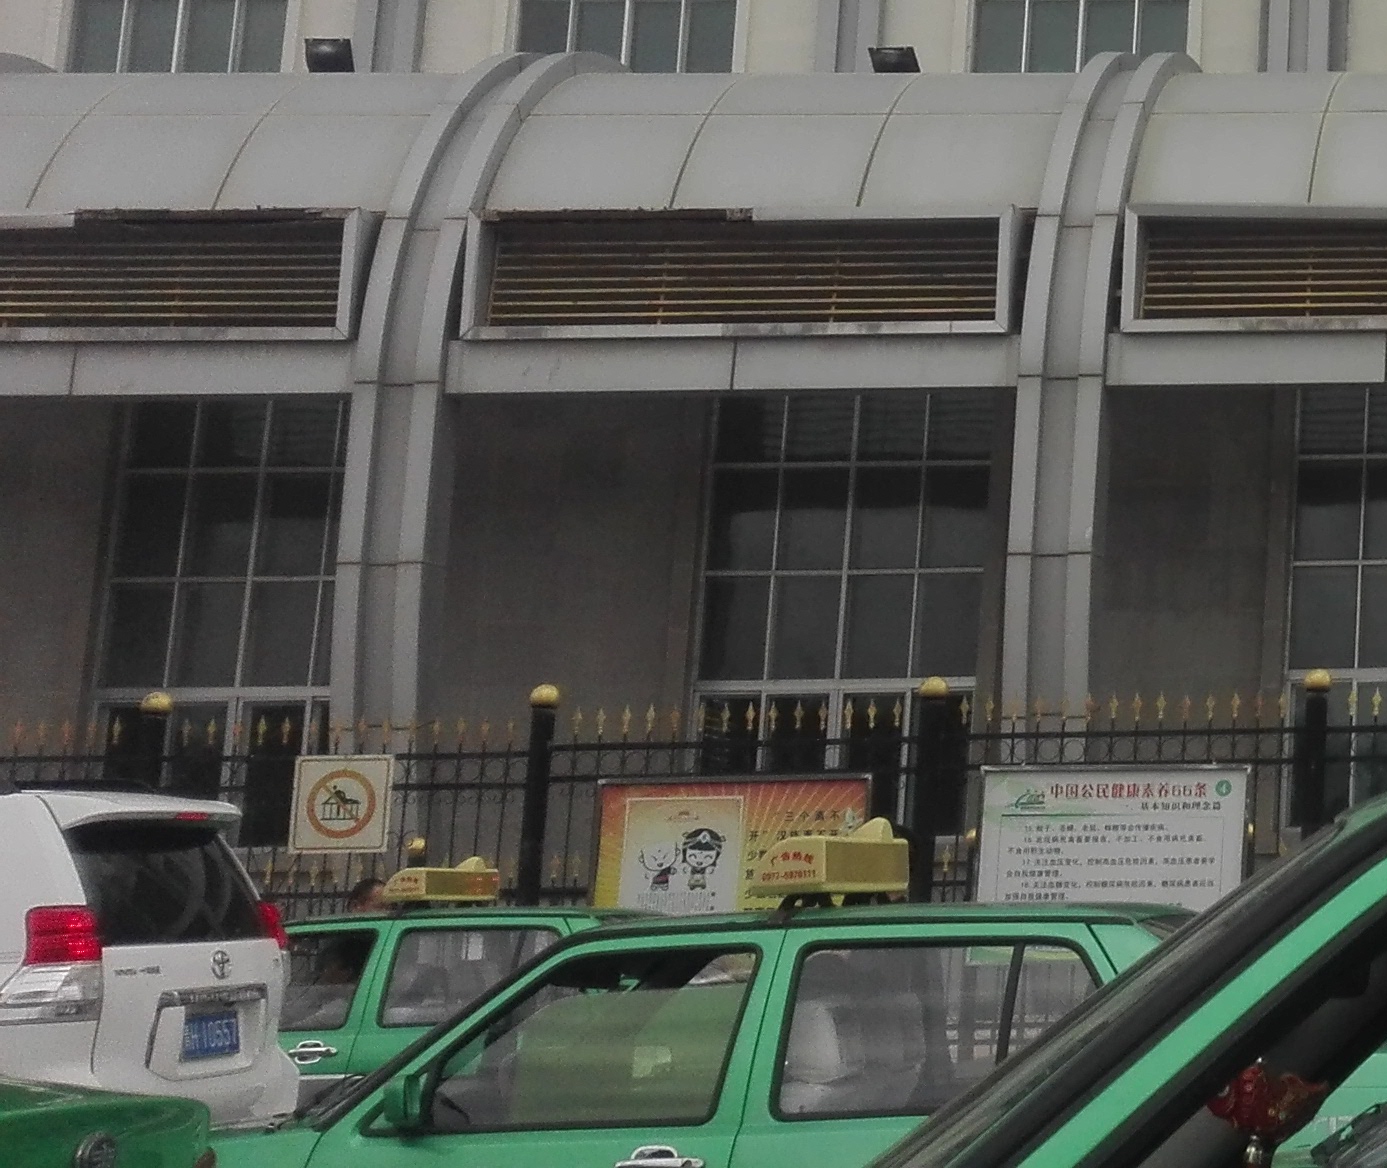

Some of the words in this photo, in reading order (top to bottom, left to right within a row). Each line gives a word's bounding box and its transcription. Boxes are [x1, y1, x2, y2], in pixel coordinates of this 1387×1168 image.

[1050, 781, 1208, 800] 中国公民健康素养66条
